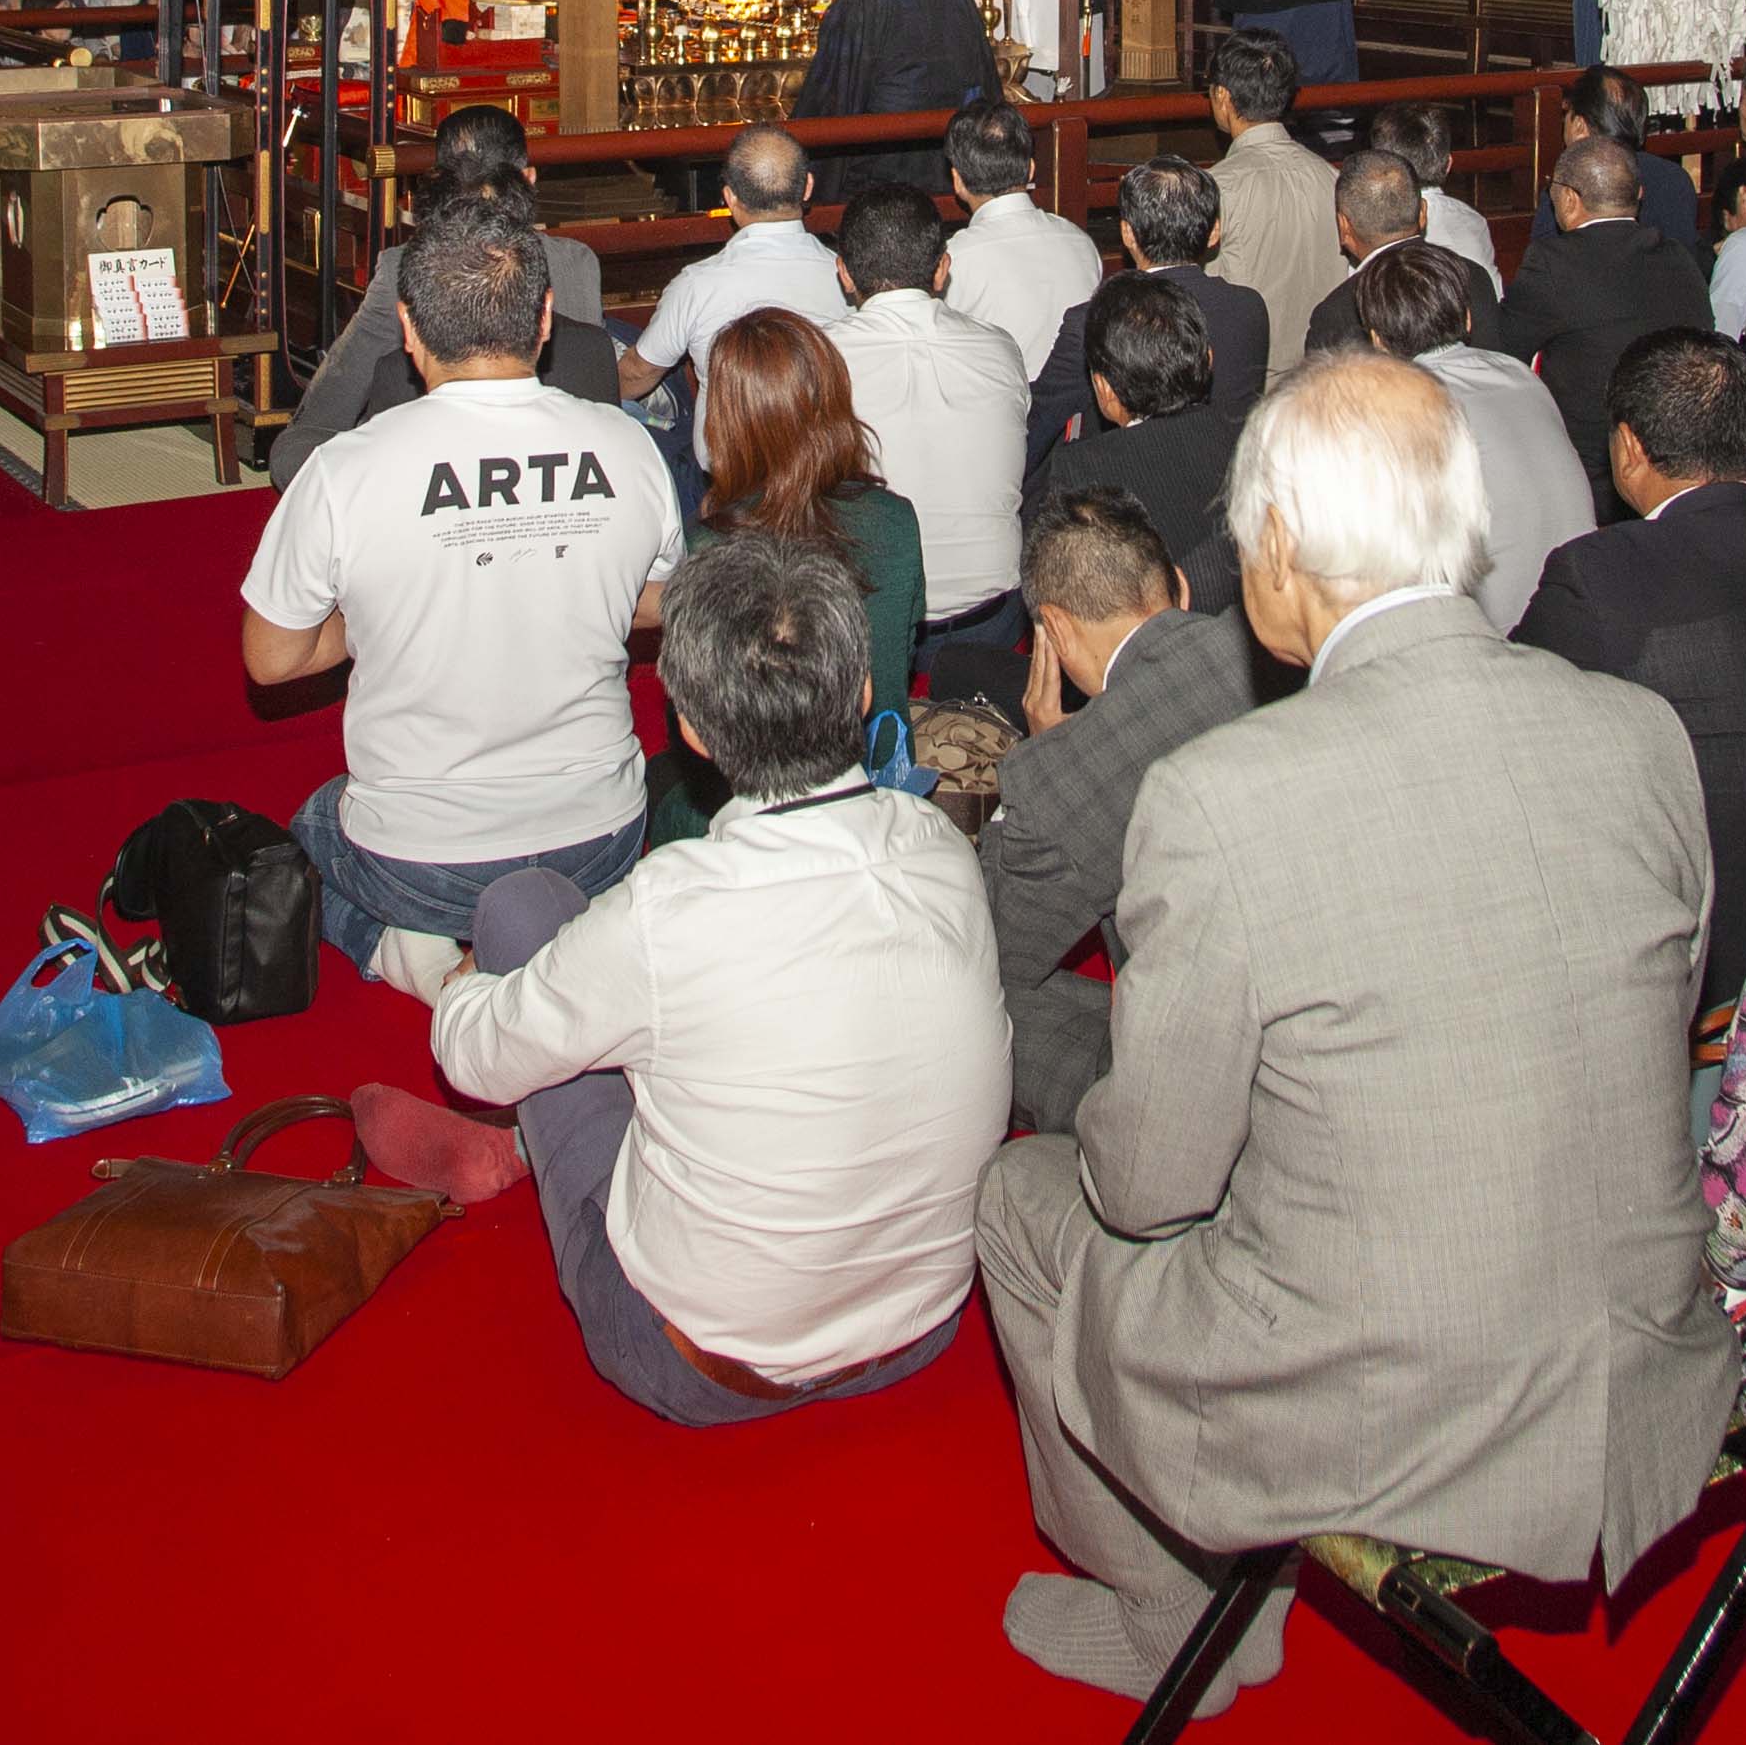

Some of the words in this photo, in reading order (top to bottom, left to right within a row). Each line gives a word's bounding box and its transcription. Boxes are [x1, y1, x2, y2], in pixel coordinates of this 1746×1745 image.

[99, 256, 168, 275] 御真言カード
[420, 451, 616, 517] ARTA
